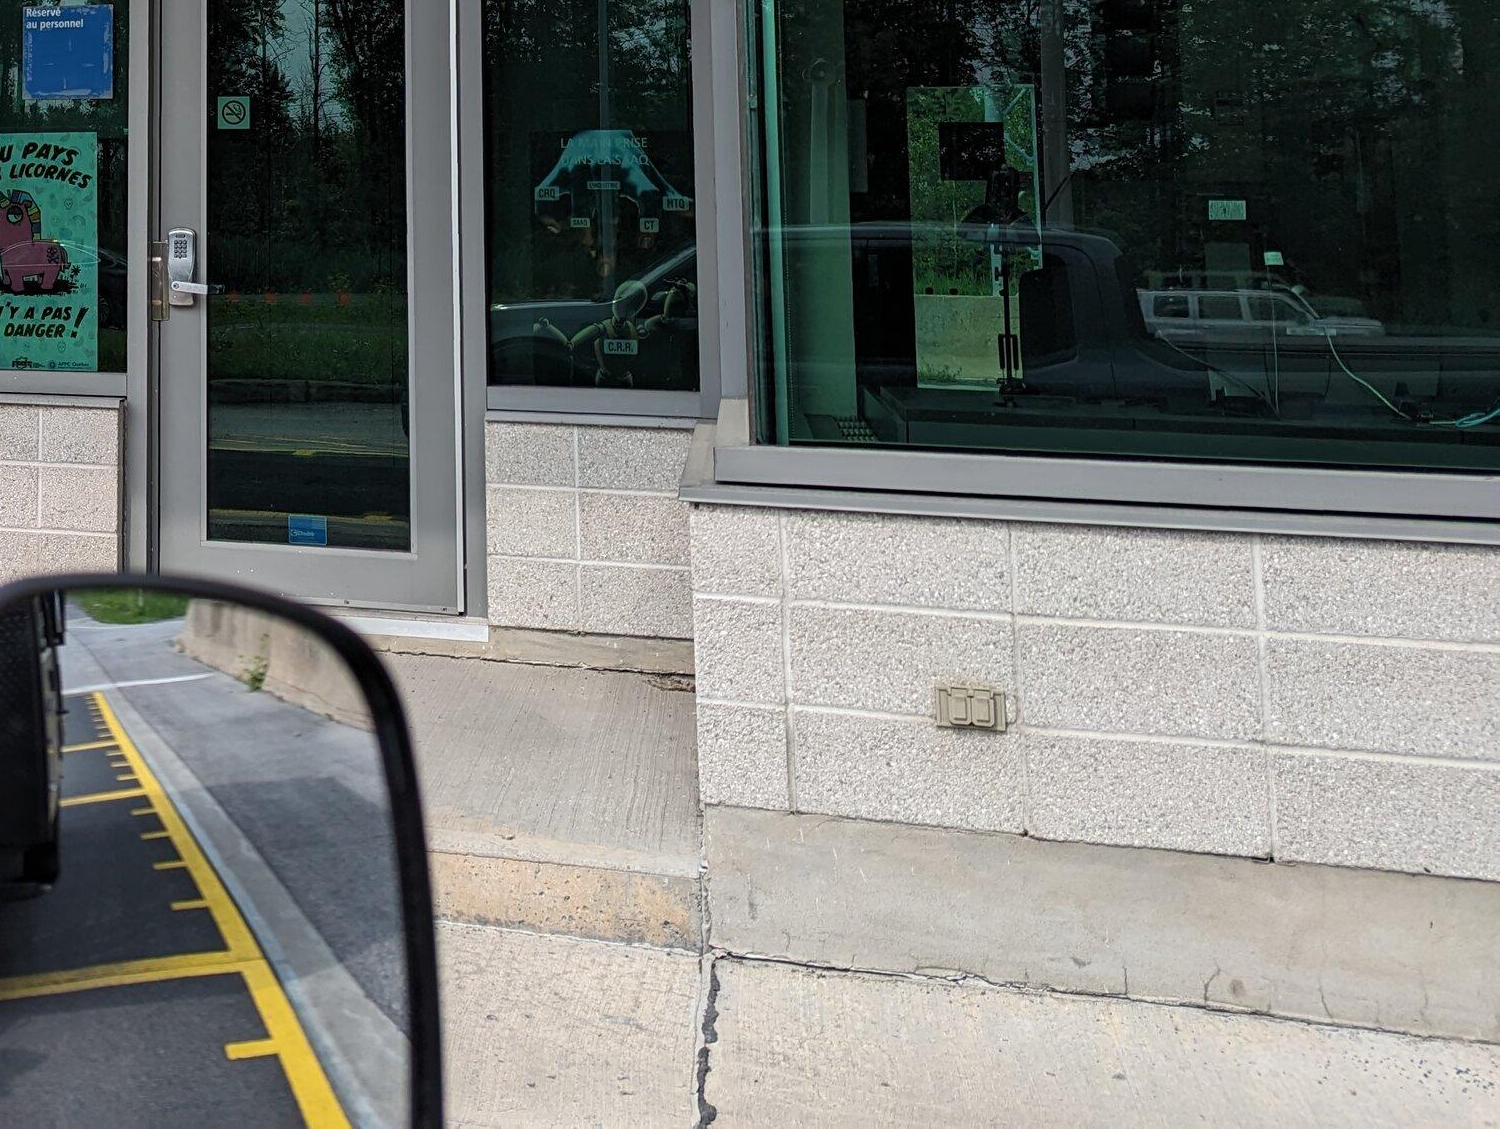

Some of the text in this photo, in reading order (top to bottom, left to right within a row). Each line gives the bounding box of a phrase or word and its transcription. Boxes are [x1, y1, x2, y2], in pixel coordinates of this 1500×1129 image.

[26, 8, 61, 17] Réservé
[26, 18, 84, 31] au personnel
[22, 142, 79, 166] PAYS
[9, 163, 92, 189] LICORNES
[23, 306, 36, 320] A
[41, 306, 72, 320] PAS
[4, 323, 66, 338] DANGER
